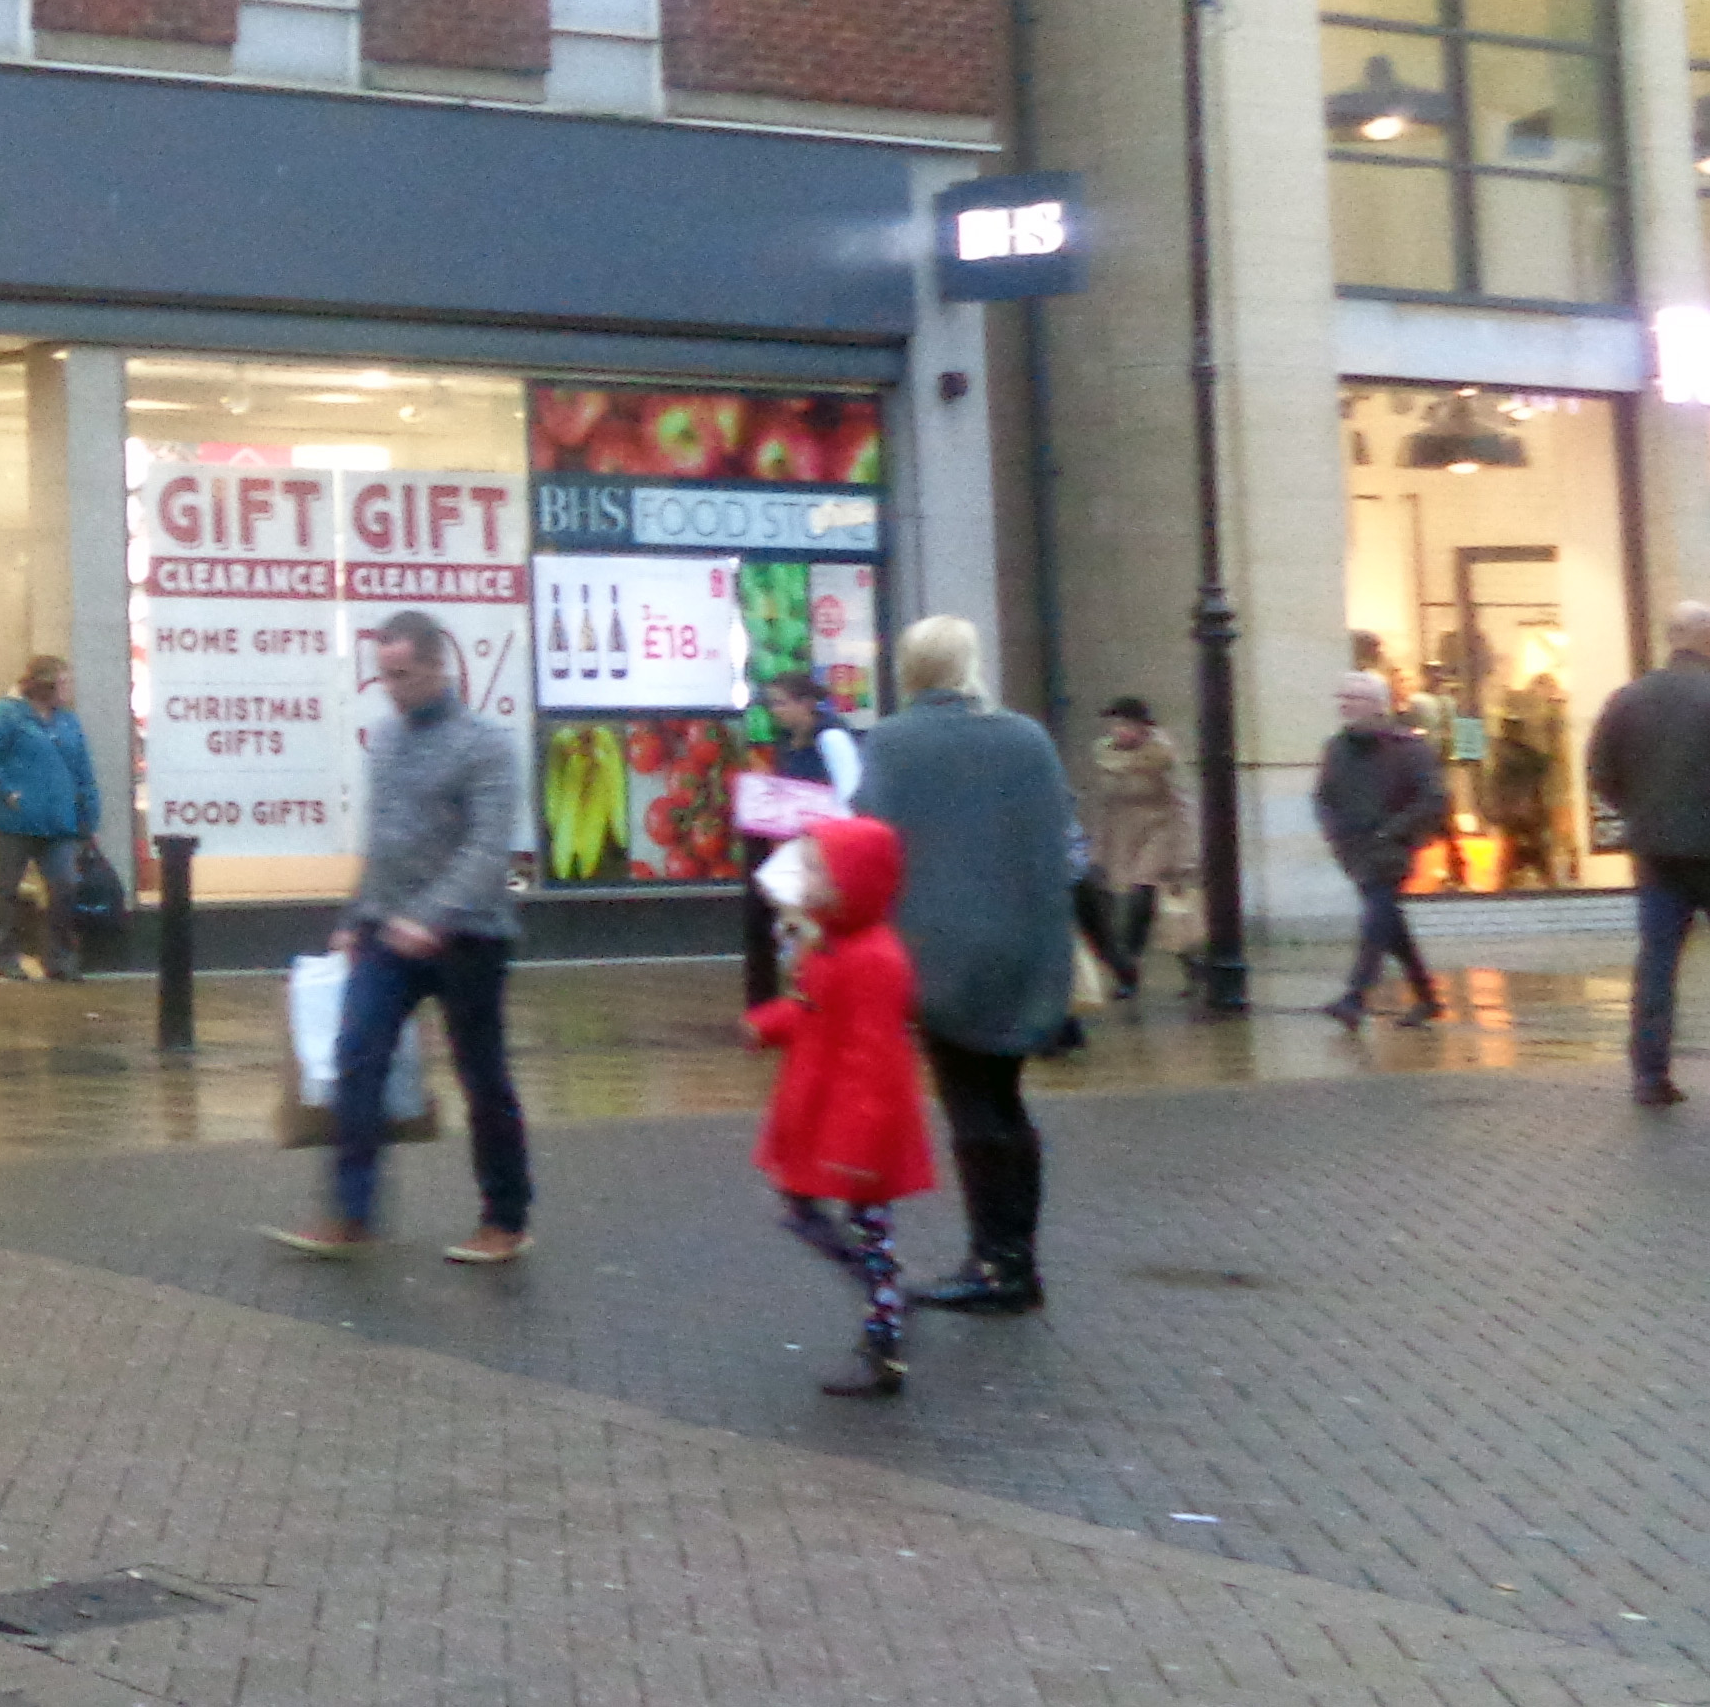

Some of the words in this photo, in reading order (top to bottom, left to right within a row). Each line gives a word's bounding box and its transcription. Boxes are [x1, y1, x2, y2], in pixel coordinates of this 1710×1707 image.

[158, 475, 322, 550] GIFT
[353, 483, 508, 556] GIFT
[539, 485, 626, 532] BHS
[639, 496, 750, 538] FOOD
[157, 562, 328, 594] CLEARANCE
[352, 567, 515, 597] CLEARANCE
[156, 626, 239, 655] HOME
[253, 628, 328, 655] GIFTS
[643, 624, 698, 659] £18
[165, 696, 323, 722] CHRISTMAS
[206, 729, 285, 755] GIFTS
[163, 799, 242, 826] FOOD
[252, 799, 327, 826] GIFTS
